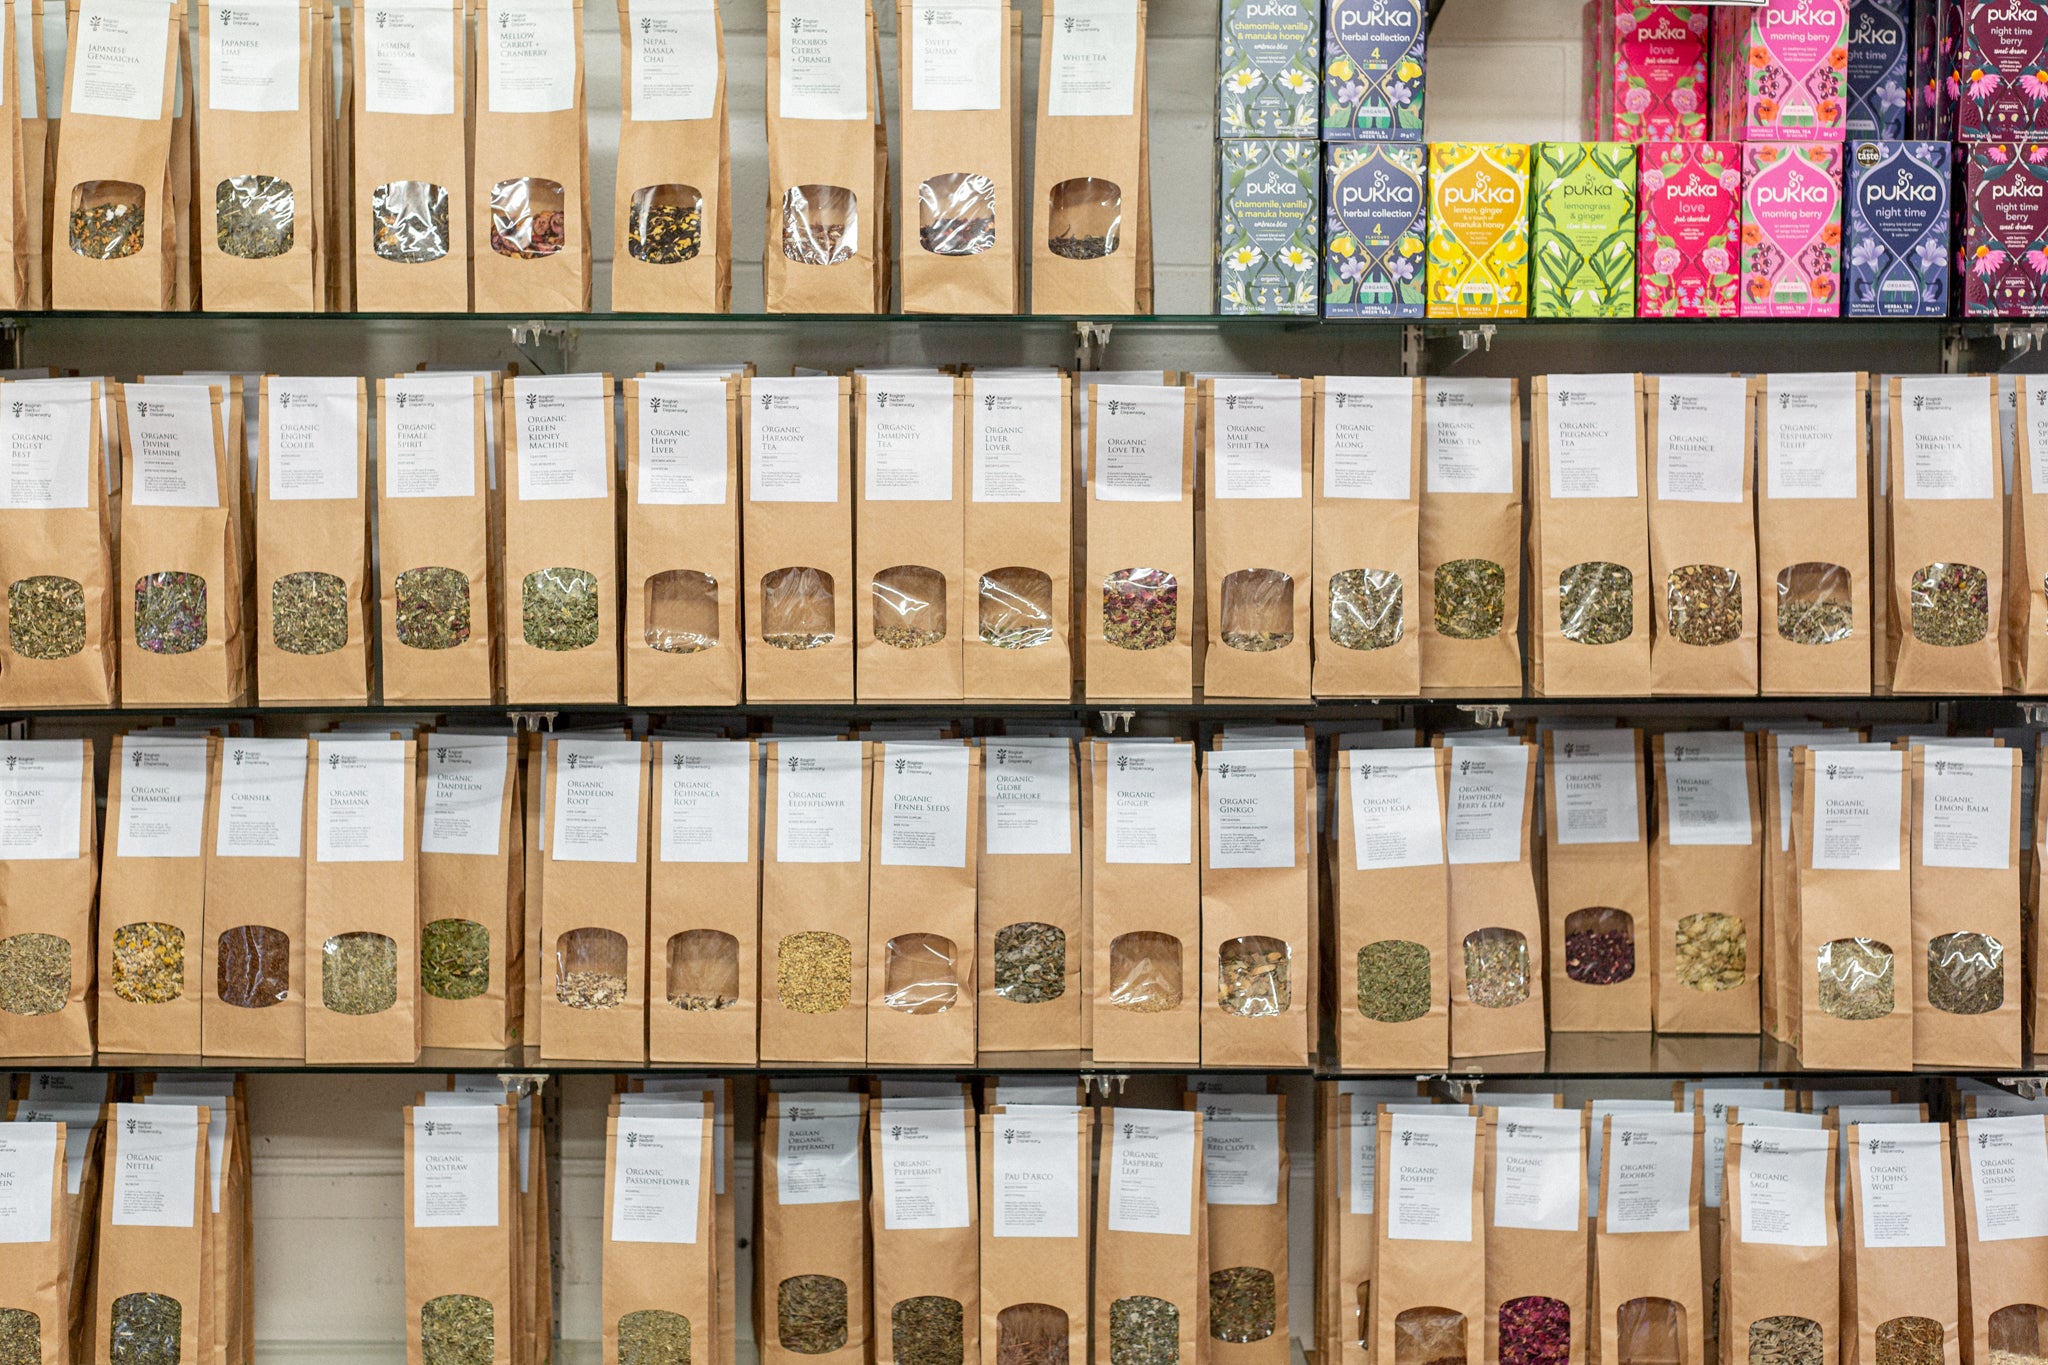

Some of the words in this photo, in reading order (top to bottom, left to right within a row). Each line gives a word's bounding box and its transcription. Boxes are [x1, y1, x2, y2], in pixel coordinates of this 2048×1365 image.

[1247, 1, 1297, 18] pukka
[1988, 4, 2037, 24] pukka
[1342, 5, 1411, 30] pukka
[1766, 4, 1835, 28] pukka
[1235, 22, 1282, 31] chamomile,
[1282, 22, 1309, 31] vanilla
[1990, 27, 2013, 37] night
[2014, 27, 2033, 35] time
[1279, 32, 1305, 42] honey
[1342, 32, 1369, 42] herbal
[1370, 33, 1410, 42] collection
[1638, 23, 1686, 42] pukka
[1770, 33, 1806, 42] morning
[1807, 32, 1830, 43] berry
[2000, 36, 2023, 48] berry
[1371, 48, 1380, 59] 4
[1649, 44, 1674, 56] love
[1999, 103, 2019, 111] organic
[1857, 152, 1879, 161] taste
[1247, 178, 1296, 197] pukka
[1343, 179, 1413, 206] pukka
[1445, 179, 1514, 206] pukka
[1564, 179, 1612, 199] pukka
[1667, 179, 1717, 200] pukka
[1757, 179, 1827, 207] pukka
[1867, 177, 1936, 205] pukka
[1992, 179, 2043, 200] pukka
[1235, 200, 1281, 209] chamomile,
[1282, 200, 1307, 209] vanilla
[1564, 203, 1611, 212] lemongrass
[1679, 201, 1705, 213] love
[1995, 202, 2018, 212] night
[2019, 202, 2039, 211] time
[1279, 210, 1305, 220] honey
[1343, 209, 1371, 218] herbal
[1372, 209, 1412, 218] collection
[1453, 207, 1477, 215] lemon,
[1479, 207, 1503, 215] ginger
[1762, 210, 1798, 220] morning
[1799, 209, 1823, 220] berry
[1876, 207, 1902, 219] night
[1904, 207, 1927, 217] time
[1578, 212, 1604, 222] ginger
[2006, 212, 2029, 222] berry
[1373, 224, 1382, 236] 4
[1483, 221, 1506, 231] honey
[1260, 276, 1281, 284] organic
